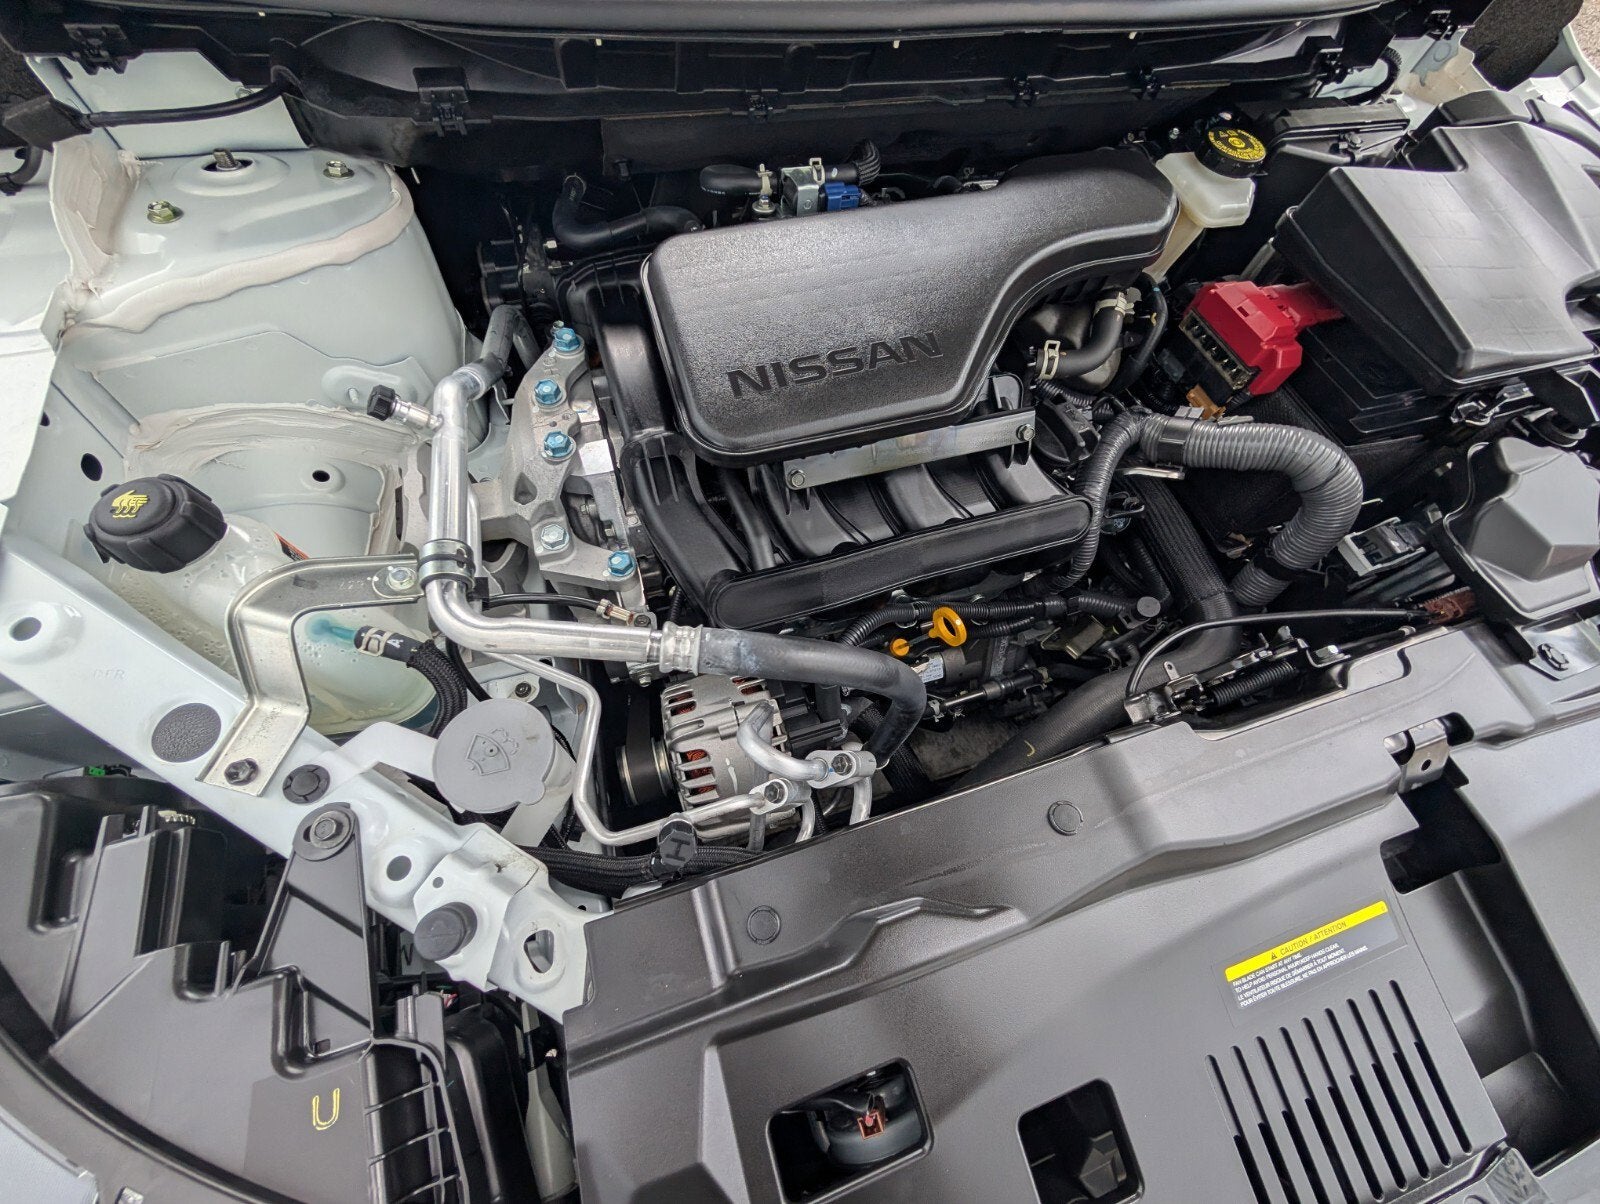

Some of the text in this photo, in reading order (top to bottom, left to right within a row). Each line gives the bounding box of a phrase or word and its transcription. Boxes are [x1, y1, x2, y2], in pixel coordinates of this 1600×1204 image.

[726, 332, 944, 398] NISSAN
[1279, 937, 1308, 955] CAUTION
[312, 1087, 340, 1130] U
